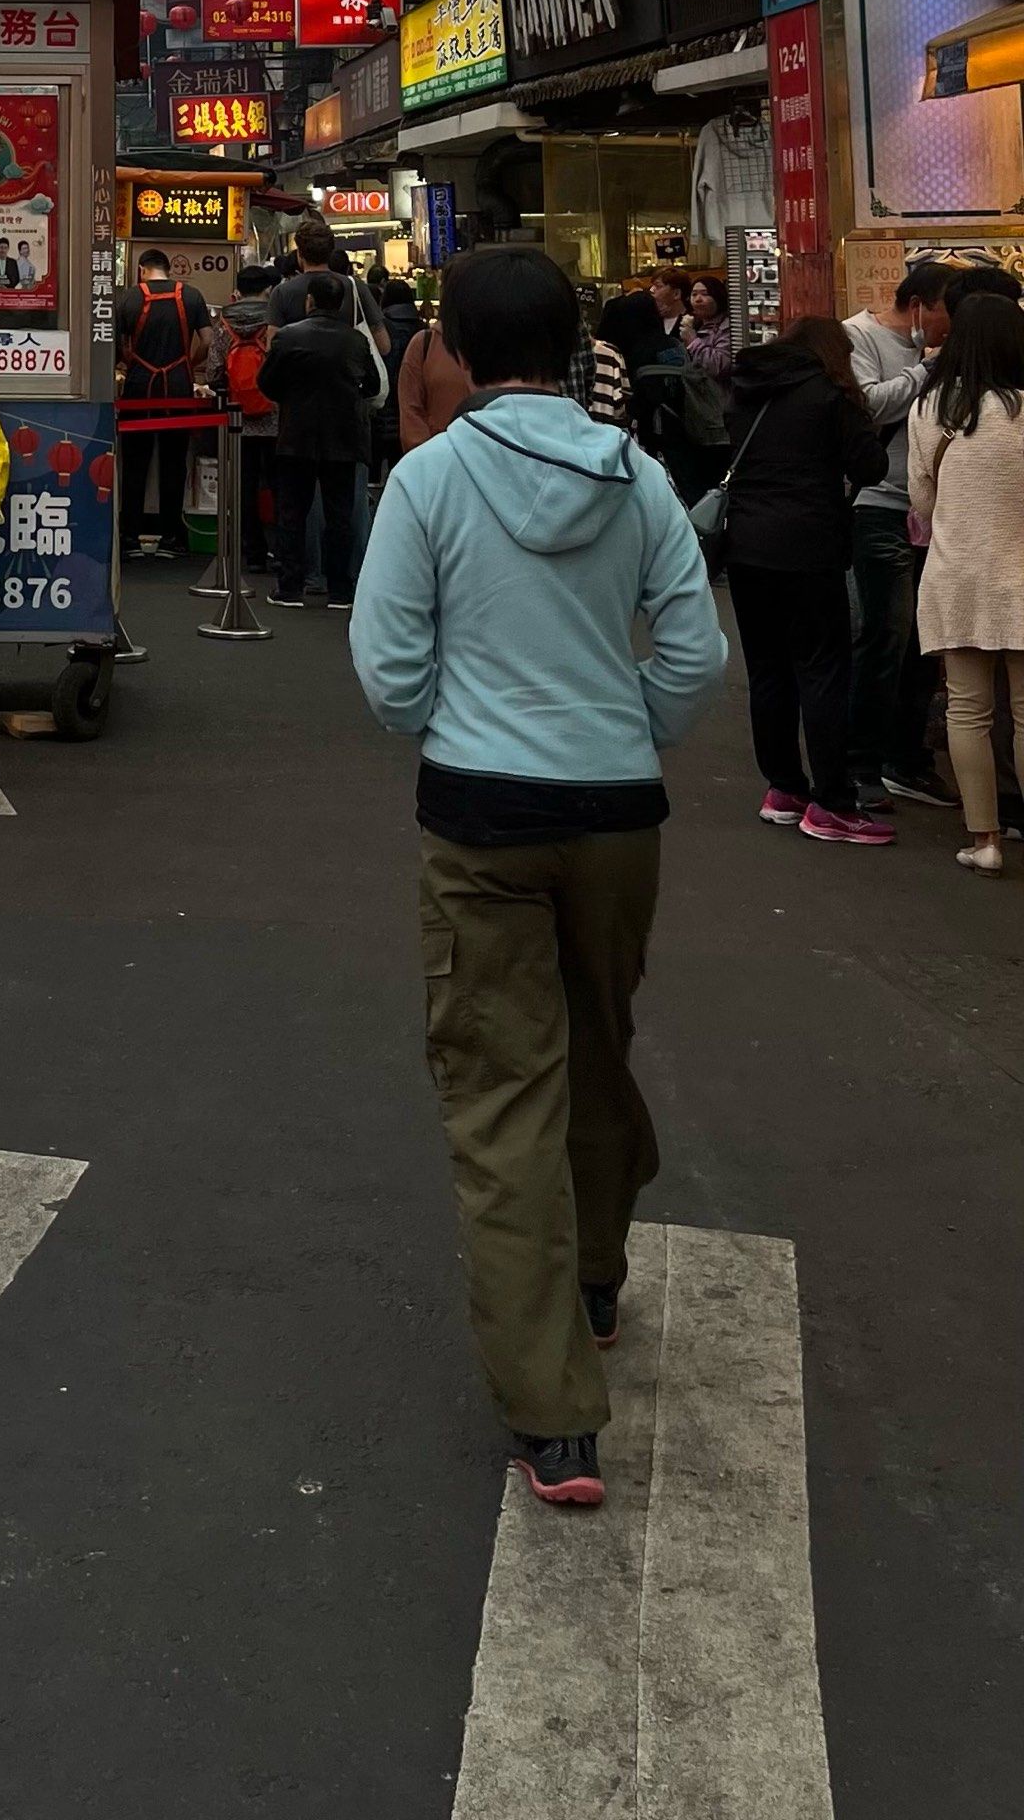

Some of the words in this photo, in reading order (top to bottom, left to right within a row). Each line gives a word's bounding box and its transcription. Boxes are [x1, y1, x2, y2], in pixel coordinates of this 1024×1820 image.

[166, 66, 249, 96] 金瑞利
[176, 98, 268, 139] 三媽臭臭鍋
[92, 166, 113, 244] 小心扒手
[164, 196, 224, 217] 胡椒餅
[91, 250, 114, 344] 請靠右走
